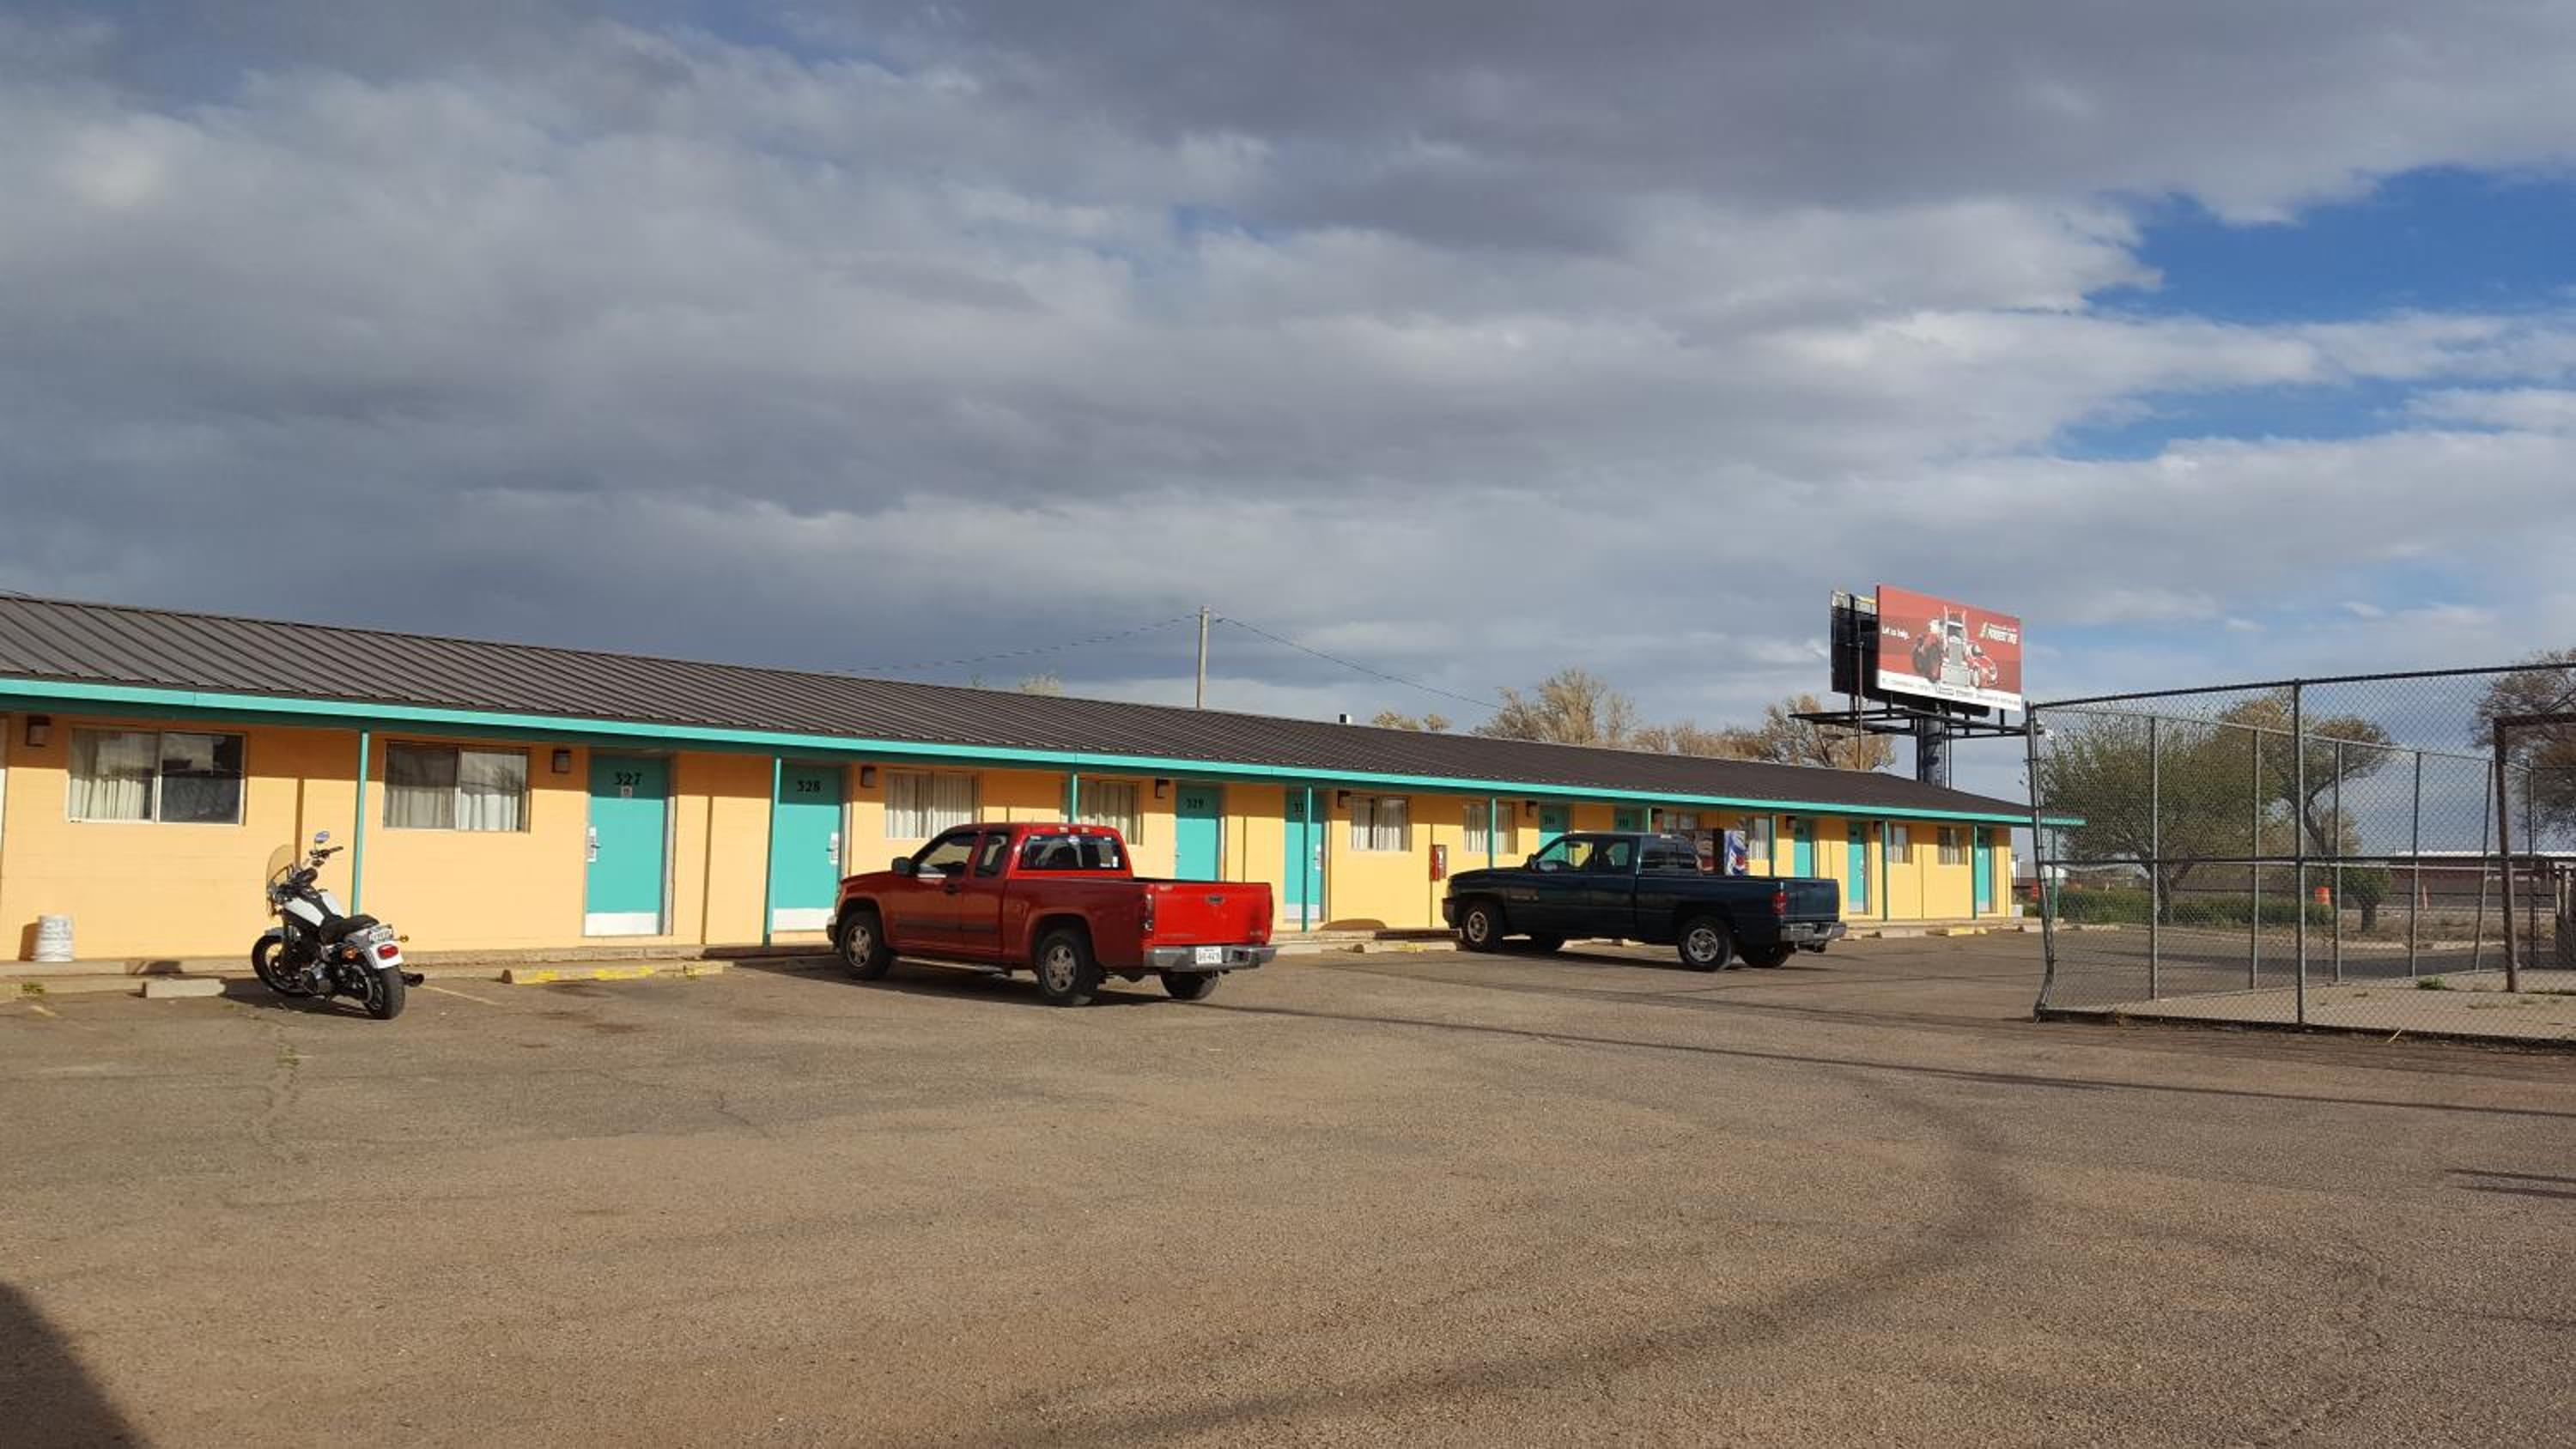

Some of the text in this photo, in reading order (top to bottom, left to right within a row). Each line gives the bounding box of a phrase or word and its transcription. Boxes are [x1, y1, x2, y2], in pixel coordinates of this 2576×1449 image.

[613, 772, 642, 785] 327
[796, 779, 821, 792] 328
[1187, 798, 1204, 809] 329
